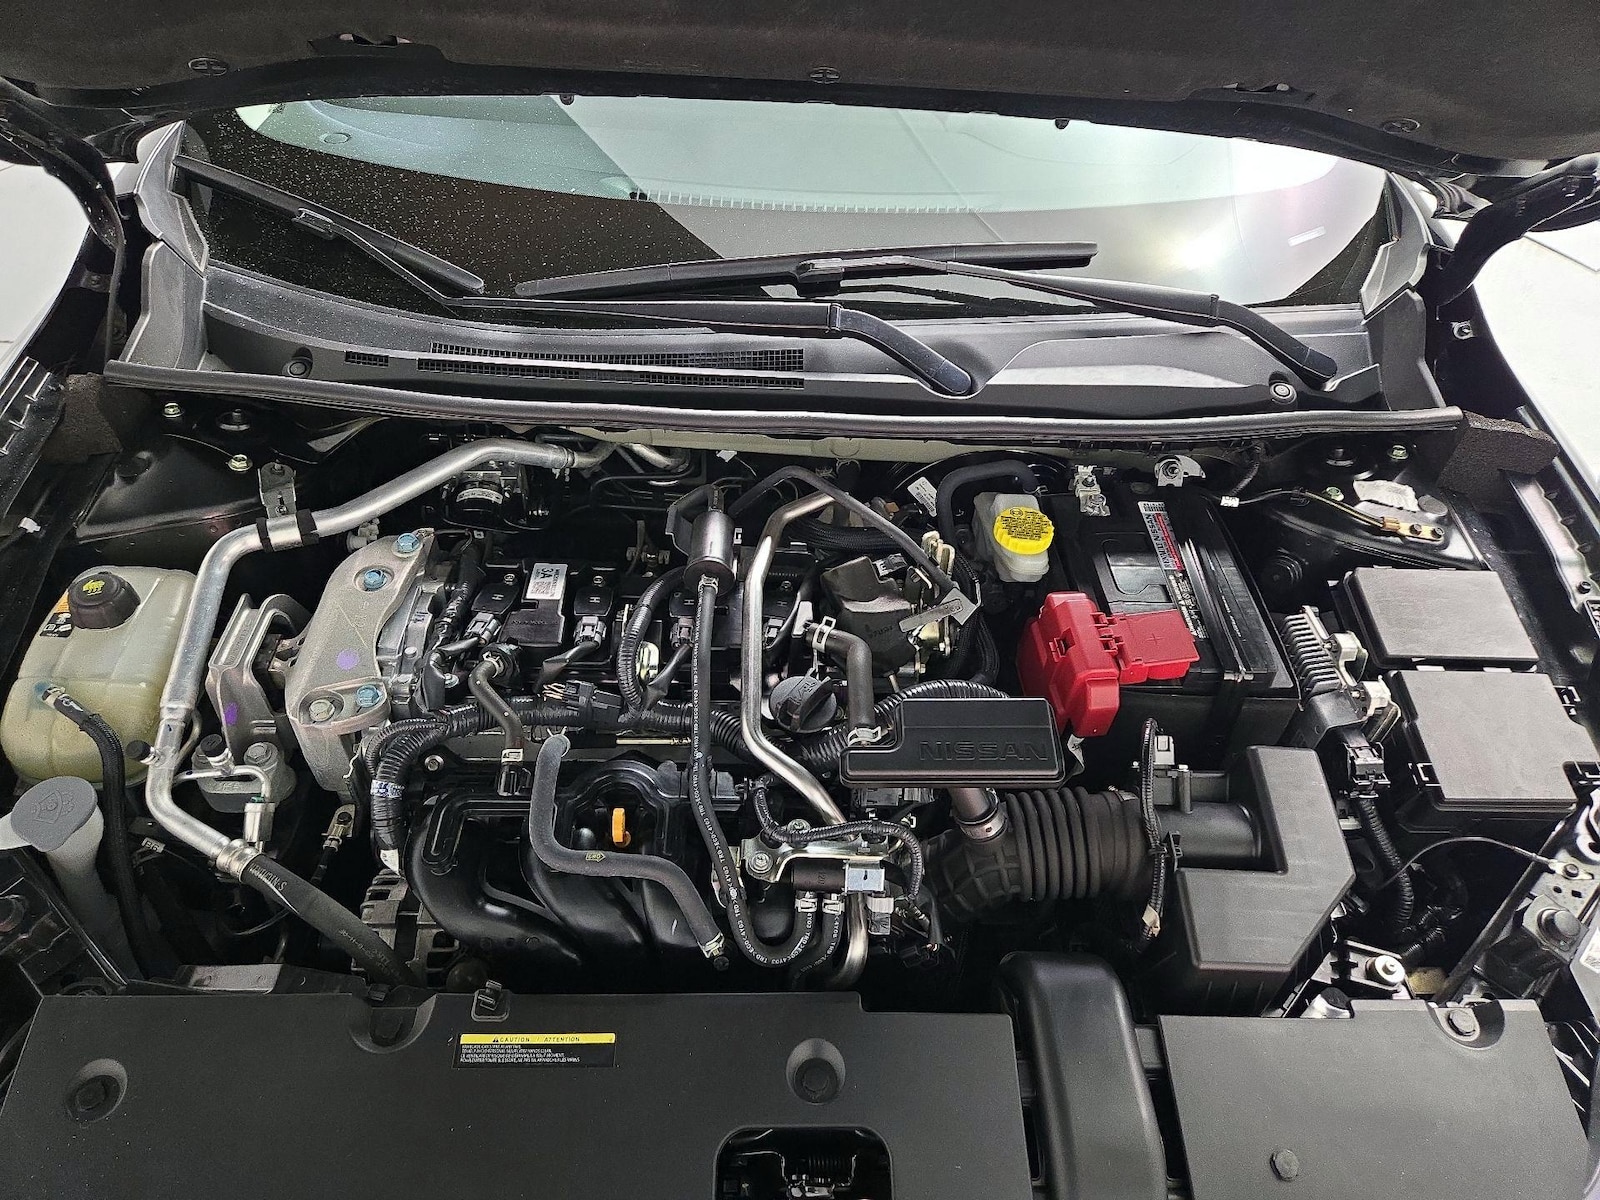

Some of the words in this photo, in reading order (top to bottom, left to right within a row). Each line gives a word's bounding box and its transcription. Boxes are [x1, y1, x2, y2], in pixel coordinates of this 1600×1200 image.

[1145, 513, 1162, 542] NISSAN
[540, 567, 554, 579] 3A
[919, 741, 1049, 761] NISSAN
